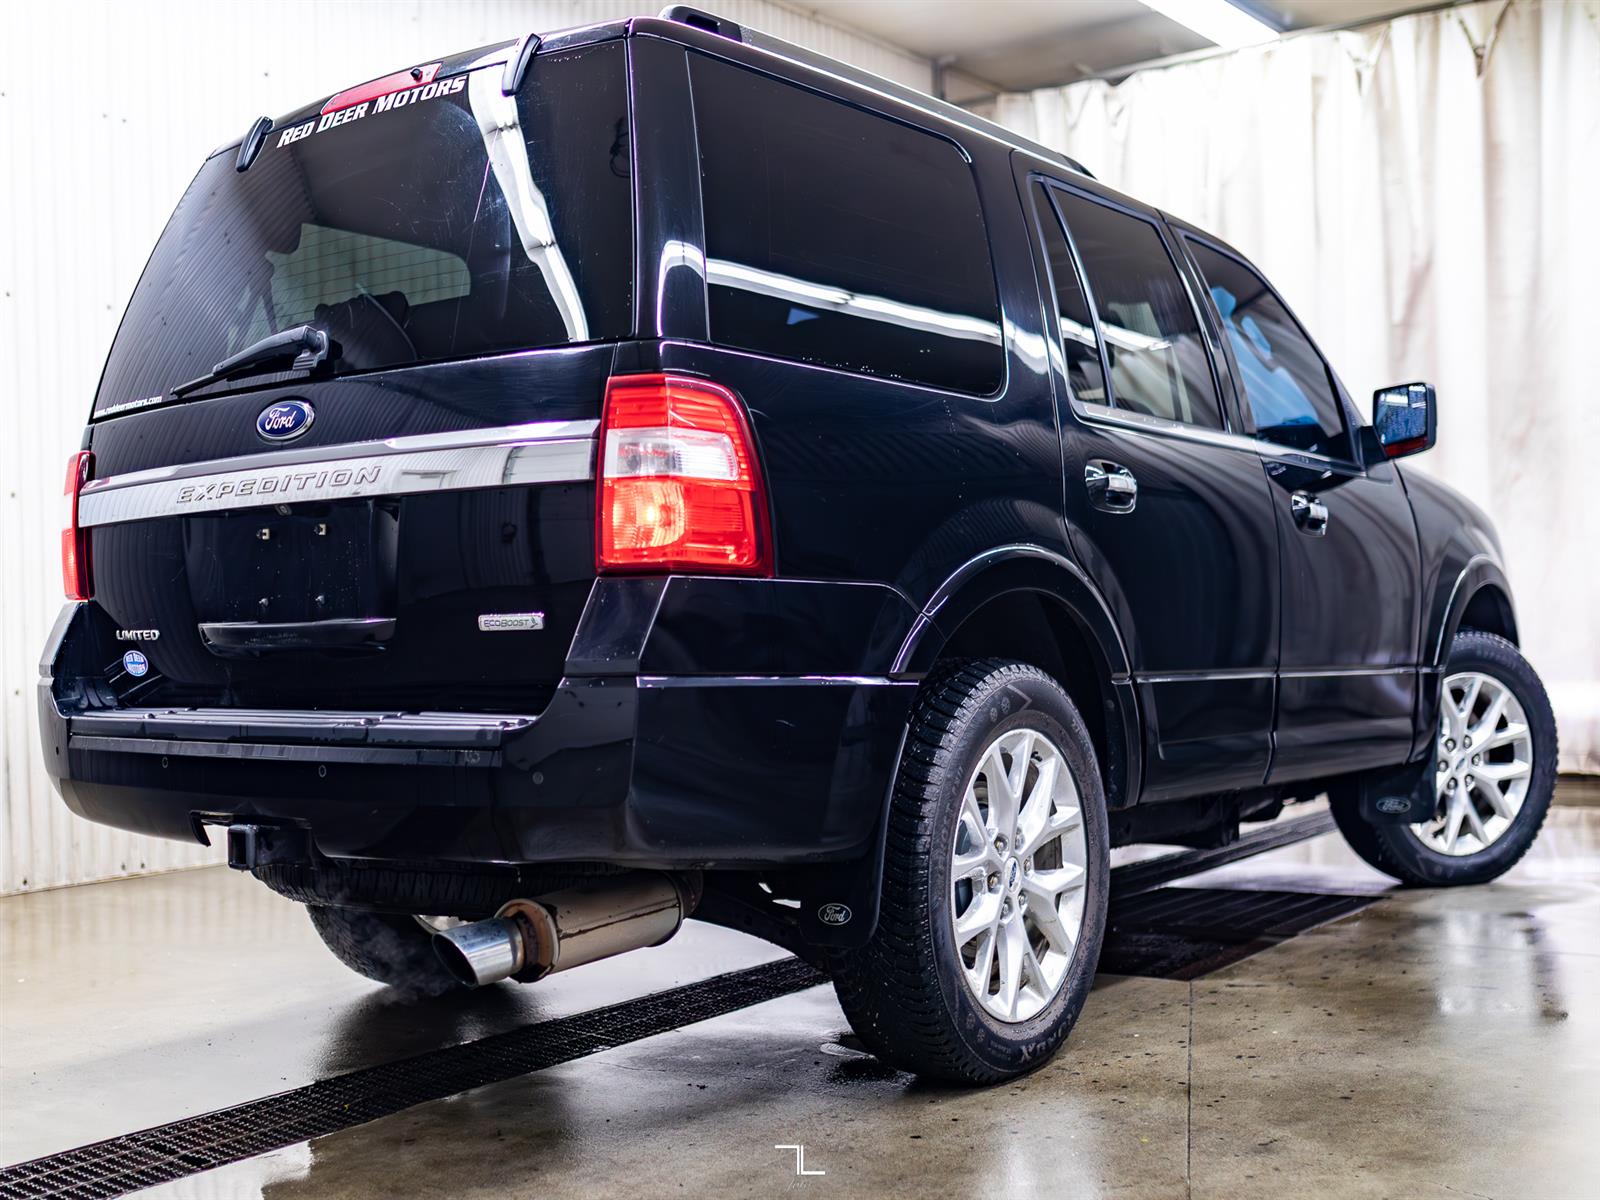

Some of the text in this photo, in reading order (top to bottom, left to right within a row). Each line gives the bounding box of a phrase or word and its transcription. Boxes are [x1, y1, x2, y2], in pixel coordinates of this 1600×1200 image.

[277, 75, 467, 148] RED DEER MOTORS
[265, 406, 296, 430] Ford
[177, 465, 382, 503] EXPEDITION
[116, 629, 160, 640] LIMITED
[824, 905, 846, 922] Ford
